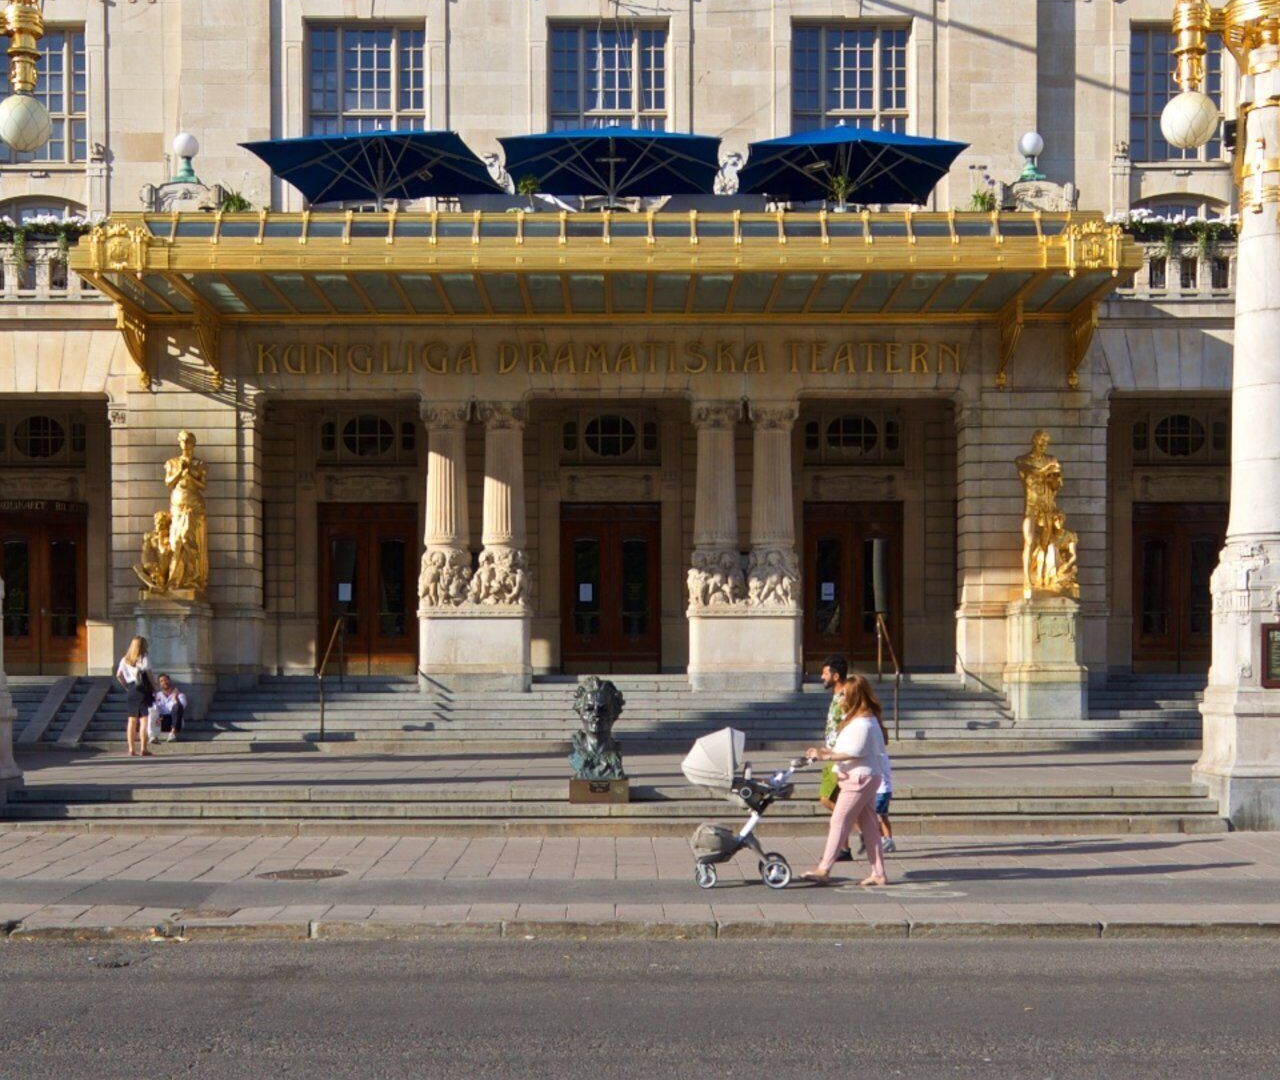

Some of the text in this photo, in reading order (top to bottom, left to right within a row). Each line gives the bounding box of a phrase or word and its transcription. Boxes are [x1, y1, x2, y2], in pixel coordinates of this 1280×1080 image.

[255, 341, 963, 375] KUNGLIGA DRAMATISKA TEATERN
